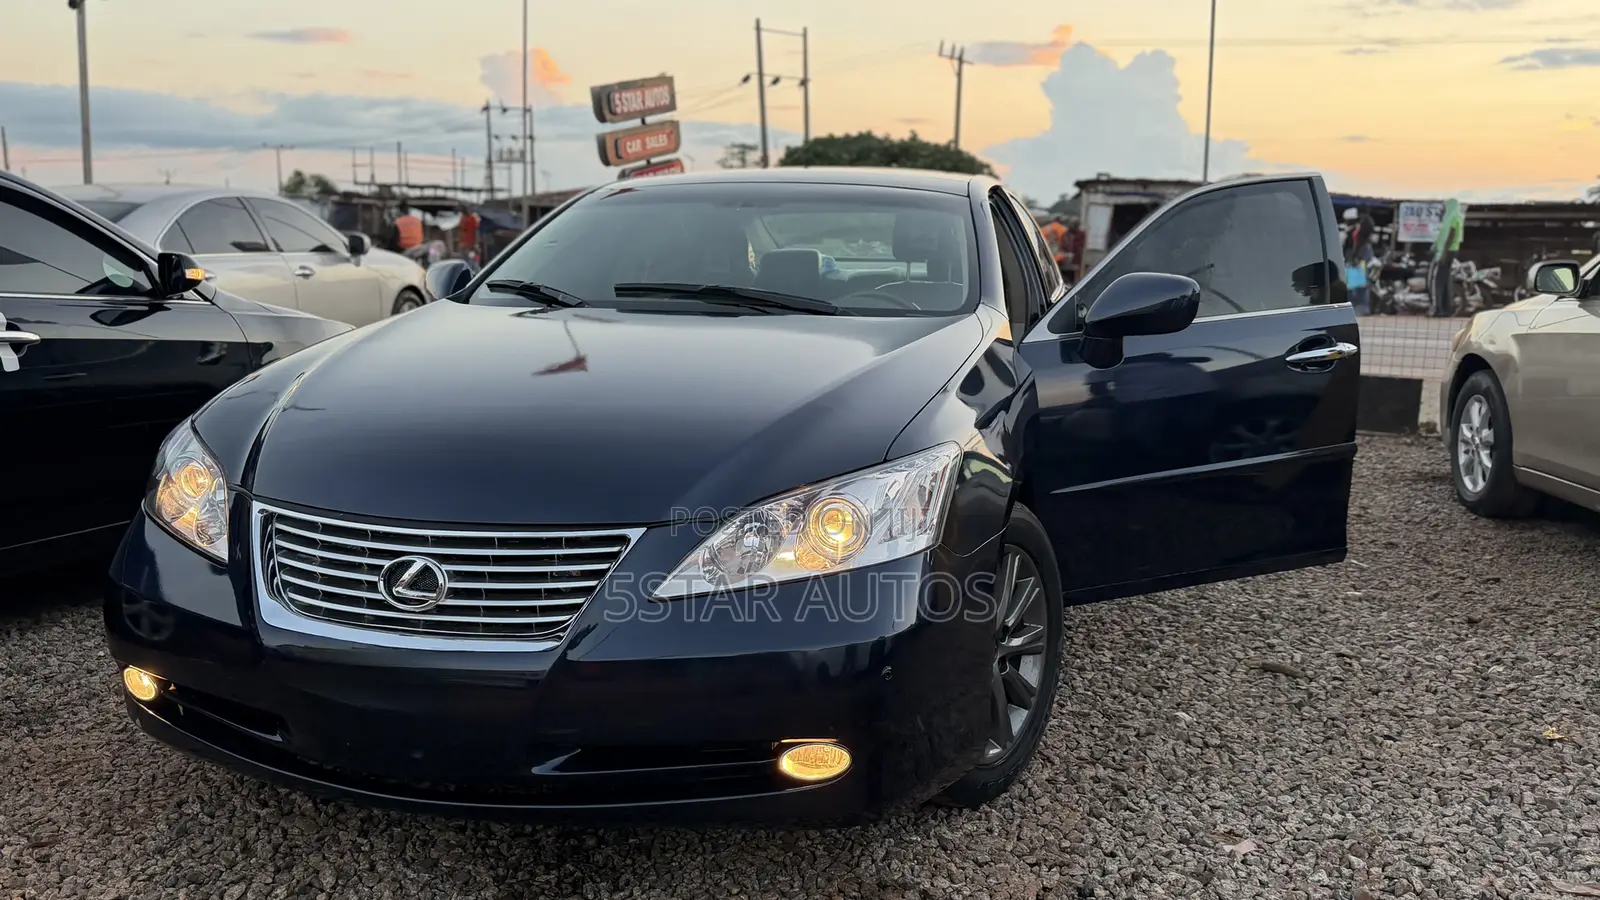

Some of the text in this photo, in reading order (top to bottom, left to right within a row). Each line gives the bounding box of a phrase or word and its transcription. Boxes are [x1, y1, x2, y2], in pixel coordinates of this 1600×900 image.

[614, 85, 670, 114] 5 STAR AUTOS
[626, 134, 668, 153] CAR SALES
